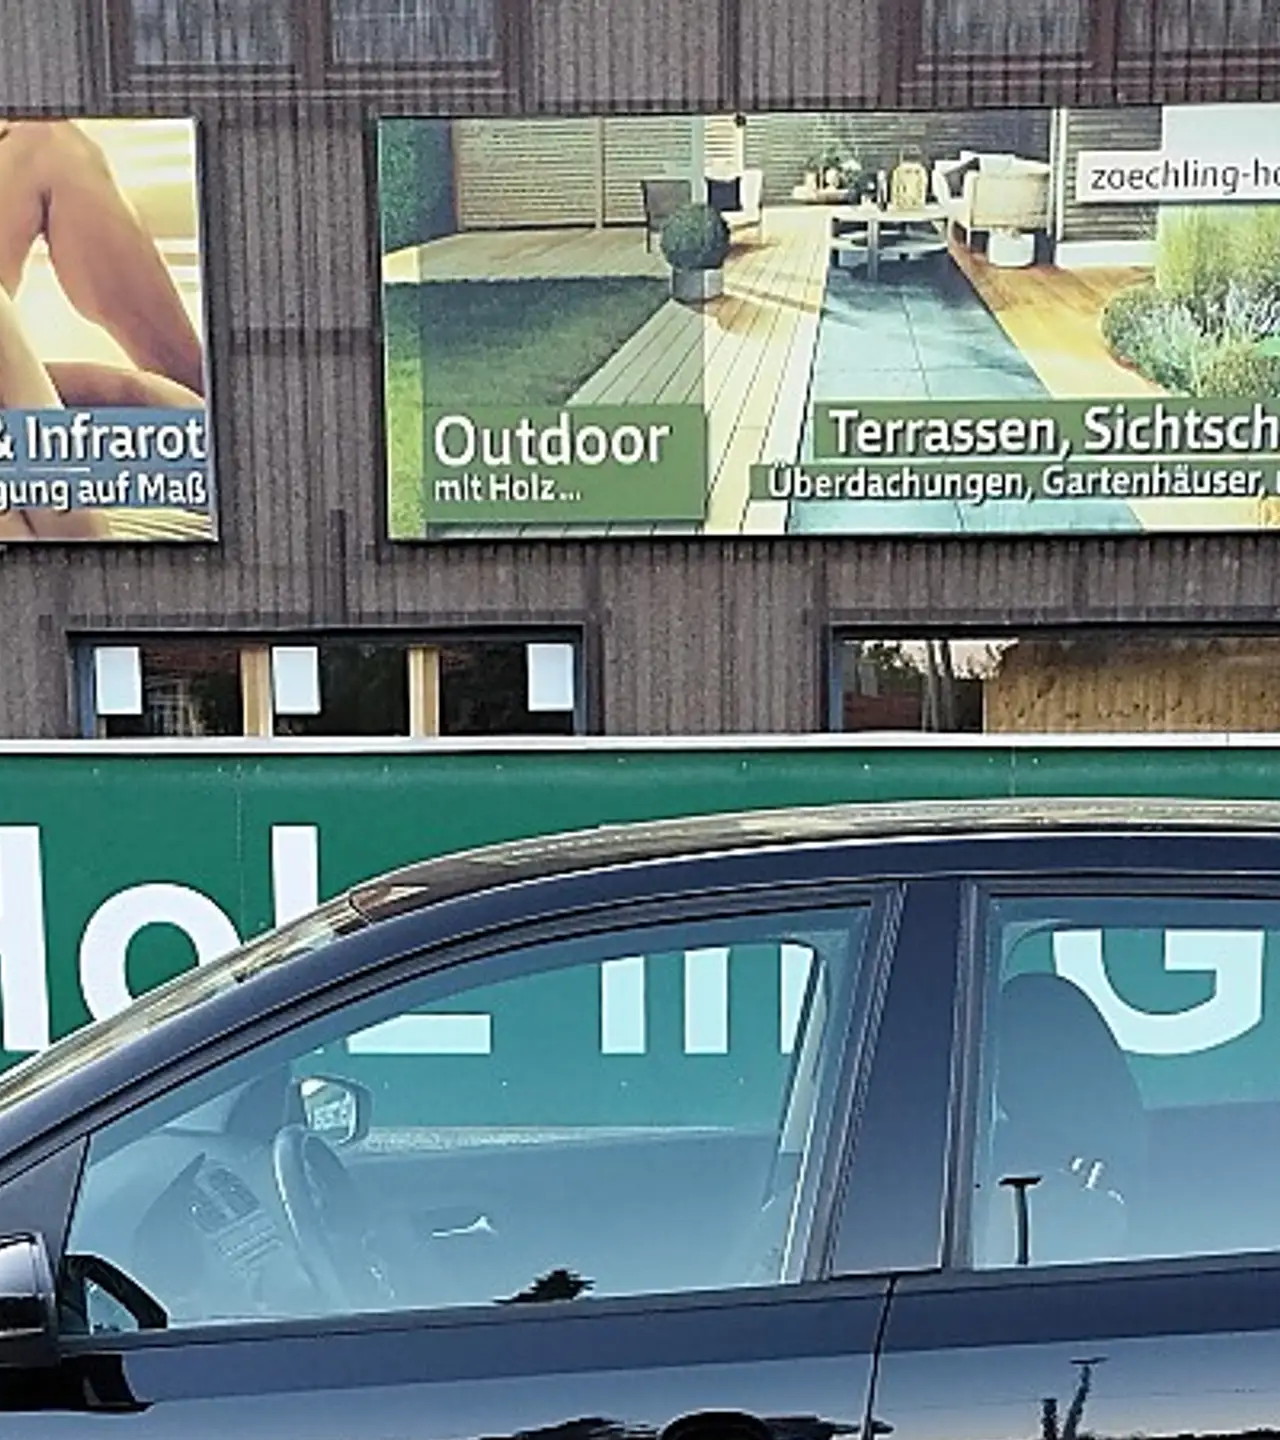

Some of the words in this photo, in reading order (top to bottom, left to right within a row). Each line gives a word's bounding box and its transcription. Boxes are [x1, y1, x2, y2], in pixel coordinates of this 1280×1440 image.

[26, 413, 207, 461] Infrarot
[434, 412, 671, 467] Outdoor
[828, 409, 1070, 460] Terrassen,
[78, 474, 130, 506] auf
[137, 474, 207, 507] Maß
[434, 473, 482, 501] mit
[769, 460, 1033, 505] Überdachungen,
[1042, 465, 1266, 498] Gartenhäuser,
